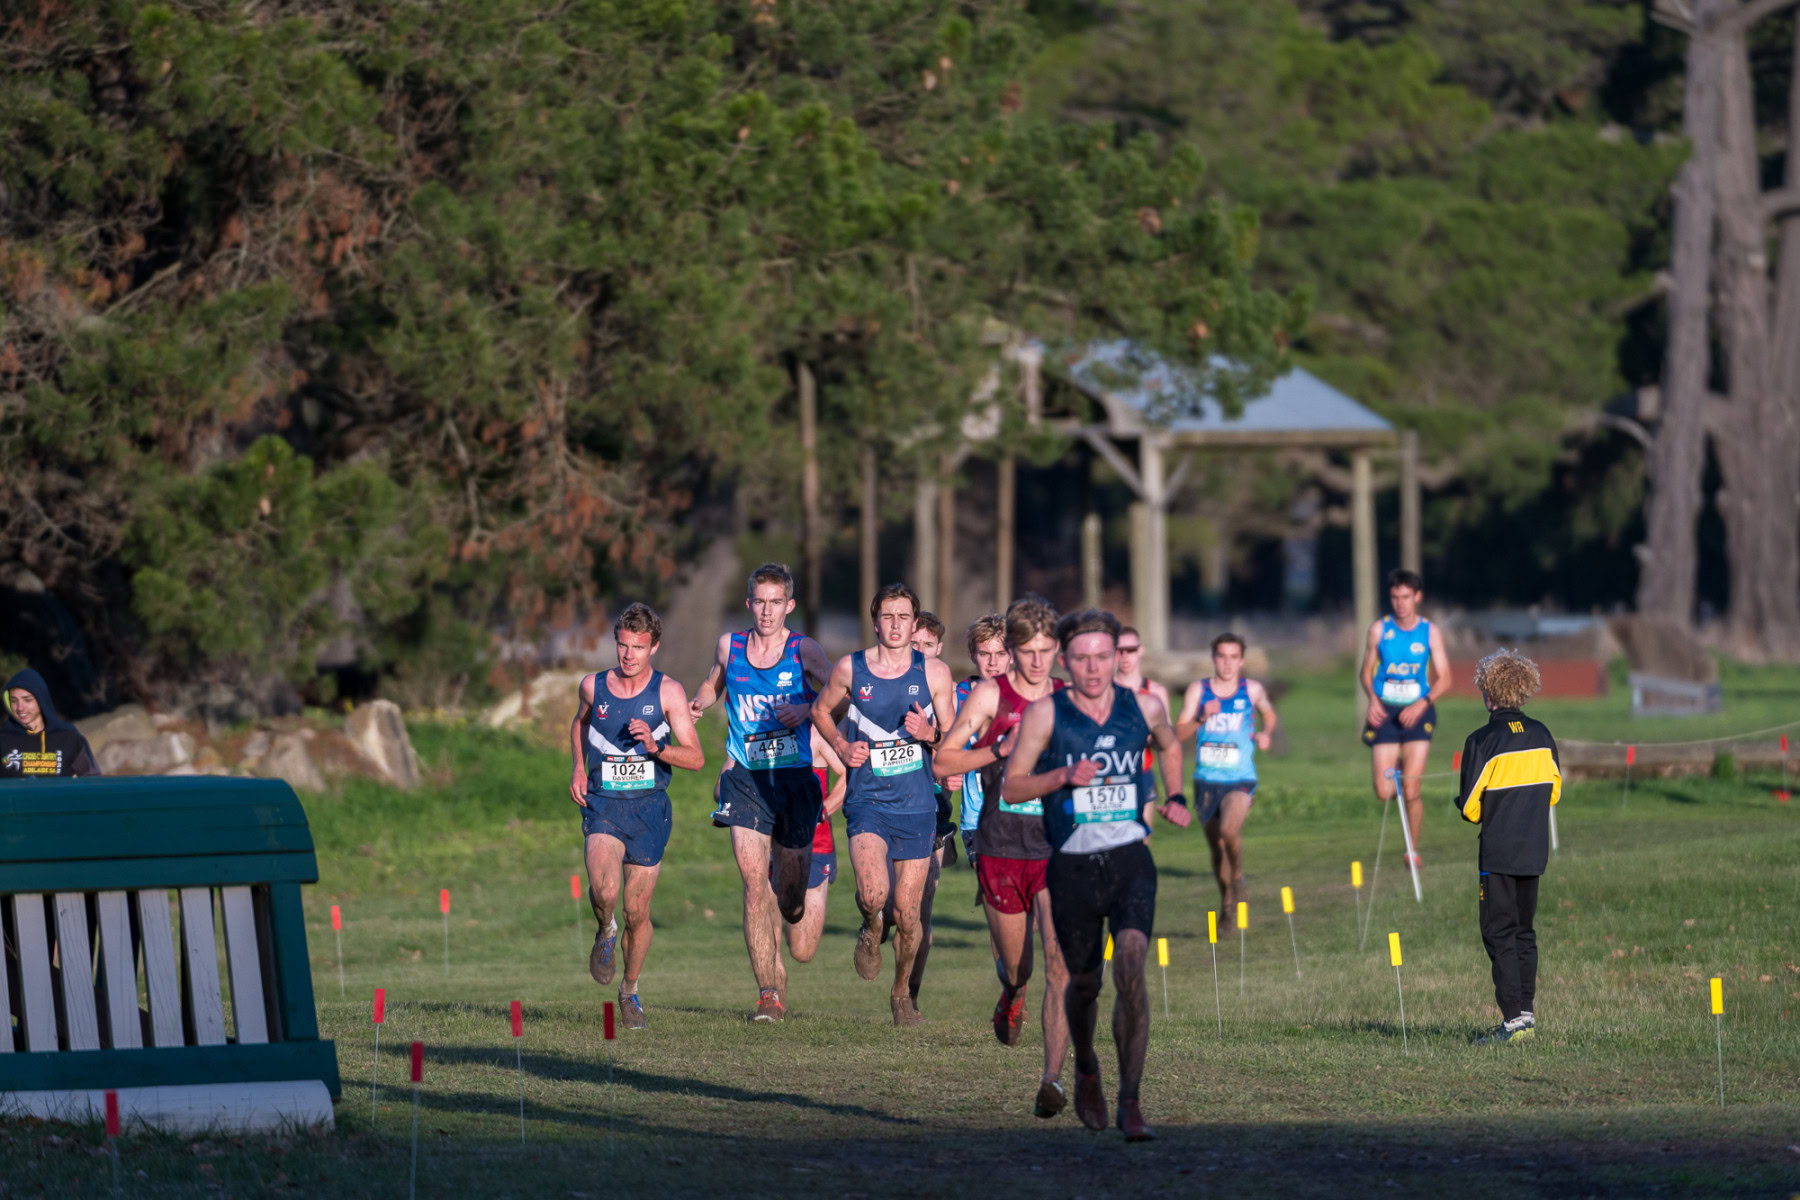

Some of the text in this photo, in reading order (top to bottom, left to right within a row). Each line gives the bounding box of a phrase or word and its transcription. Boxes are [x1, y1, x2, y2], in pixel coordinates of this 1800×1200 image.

[1386, 662, 1420, 676] ACT
[1205, 712, 1243, 732] NSW
[1508, 721, 1524, 733] WA
[759, 738, 785, 753] 445
[881, 746, 914, 761] 1226
[611, 763, 645, 776] 1024
[1086, 786, 1126, 803] 1570
